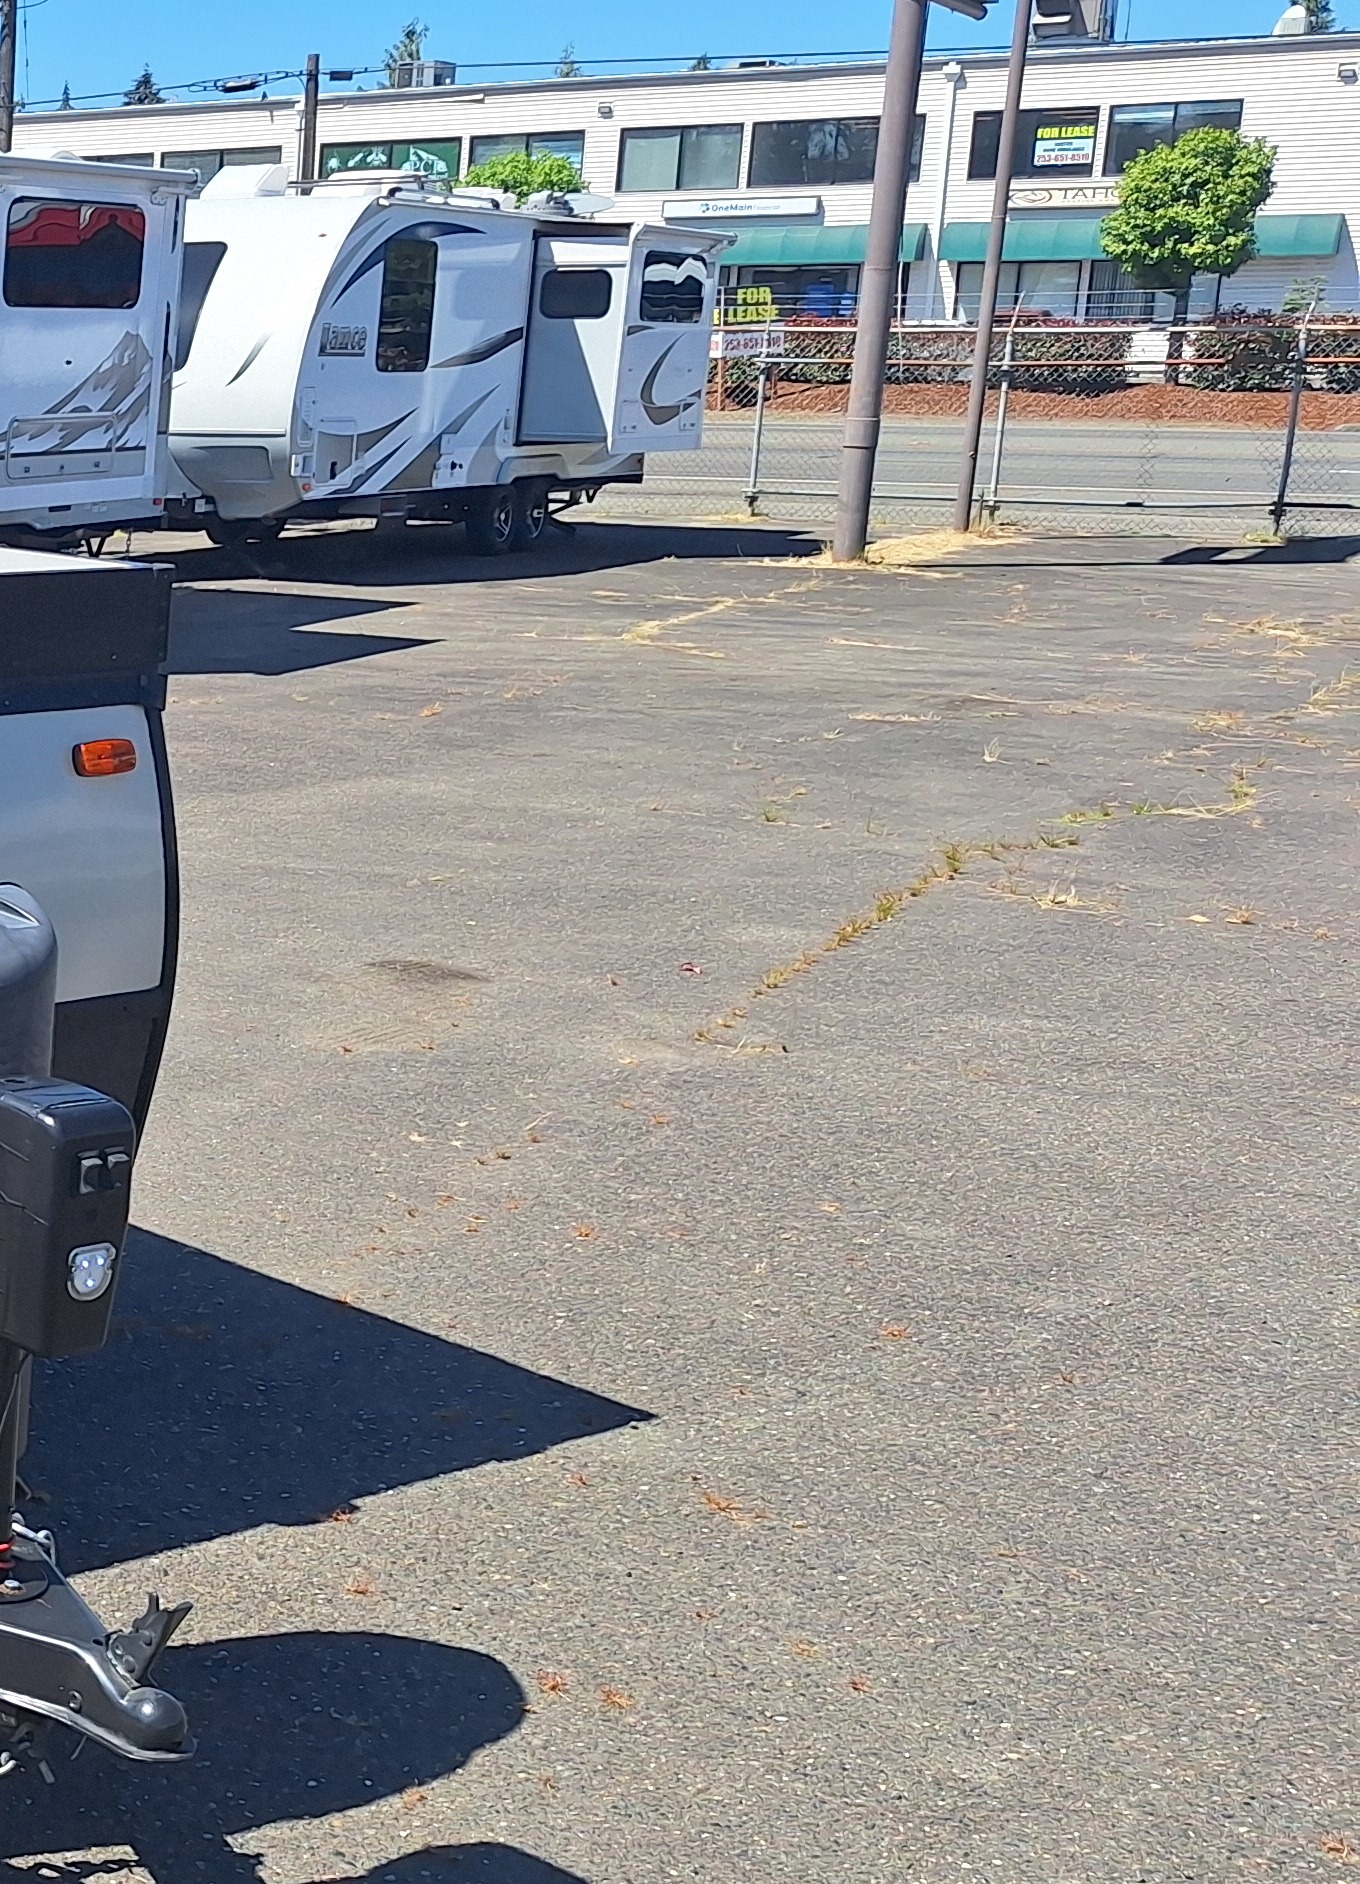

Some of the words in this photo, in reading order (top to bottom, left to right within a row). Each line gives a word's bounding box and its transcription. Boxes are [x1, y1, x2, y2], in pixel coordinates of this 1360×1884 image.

[1036, 127, 1060, 138] FOR
[1061, 125, 1096, 137] LEASE
[711, 203, 753, 212] OneMain
[737, 287, 771, 304] FOR
[728, 305, 779, 324] LEASE
[318, 322, 368, 357] Lance
